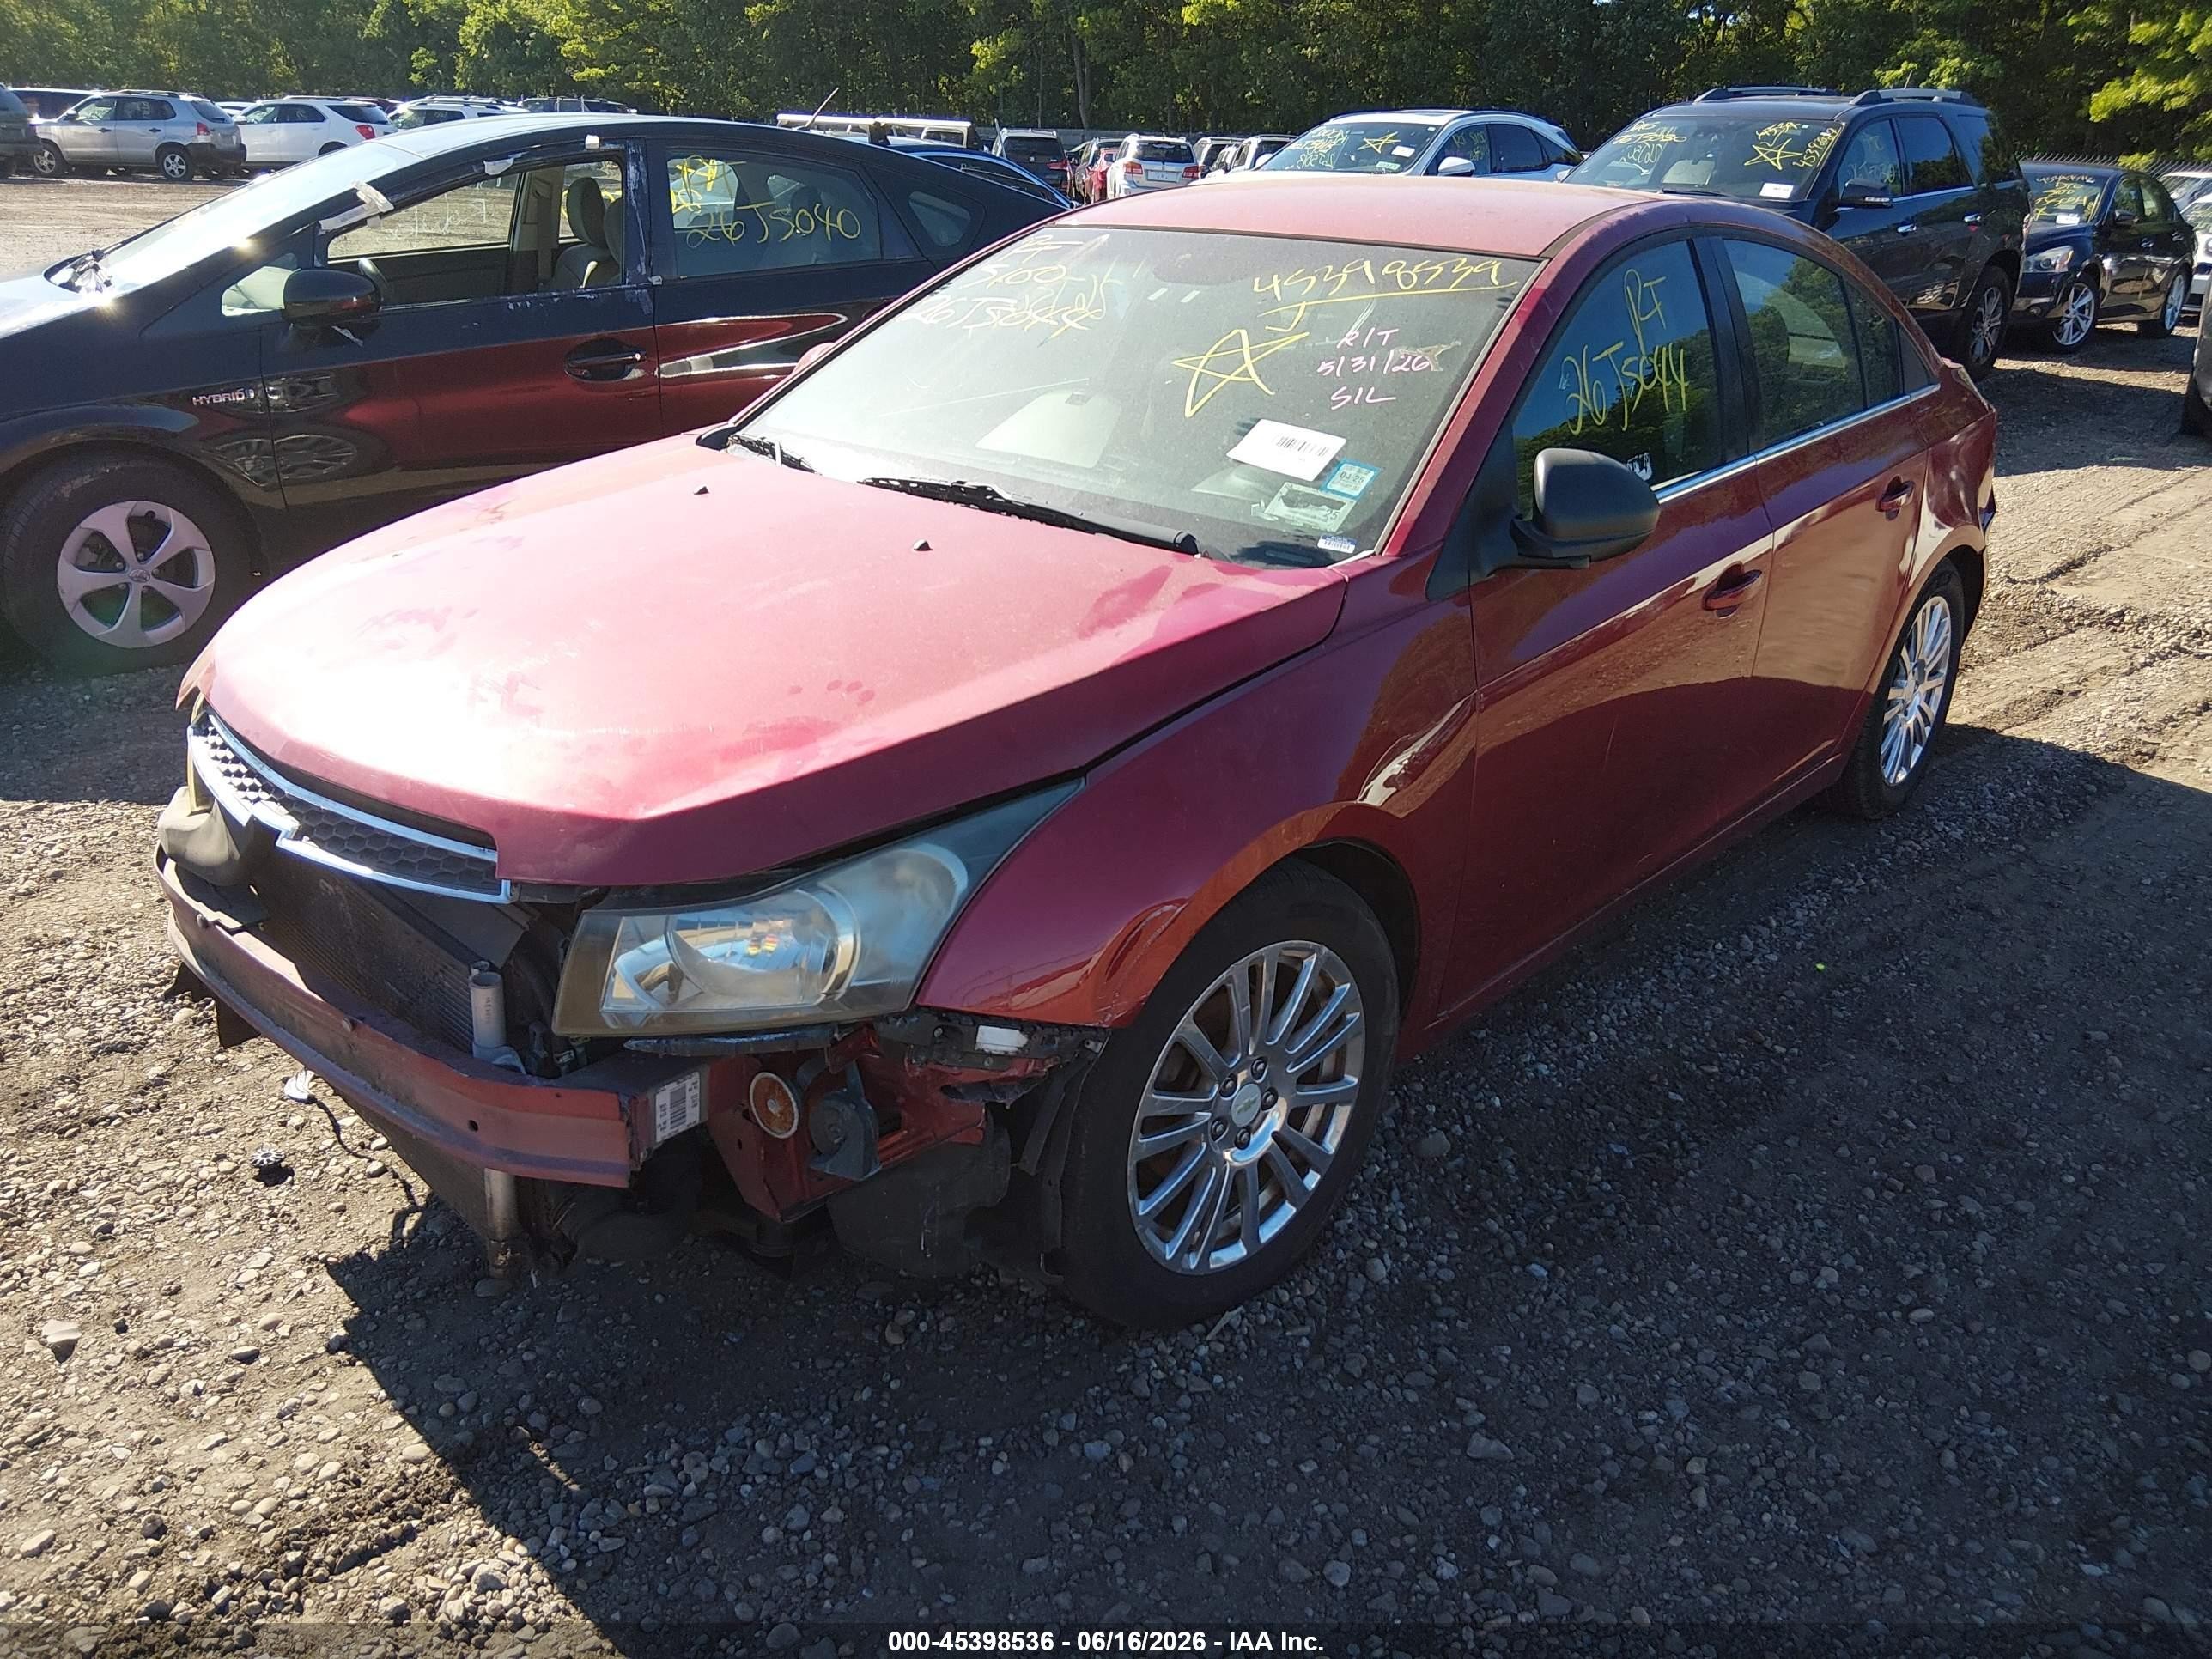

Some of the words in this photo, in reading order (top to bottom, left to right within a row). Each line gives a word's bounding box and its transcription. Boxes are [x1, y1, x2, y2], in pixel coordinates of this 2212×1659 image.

[686, 201, 860, 249] 26J5040
[191, 389, 246, 406] HYBRID
[1562, 342, 1690, 436] 26J5044
